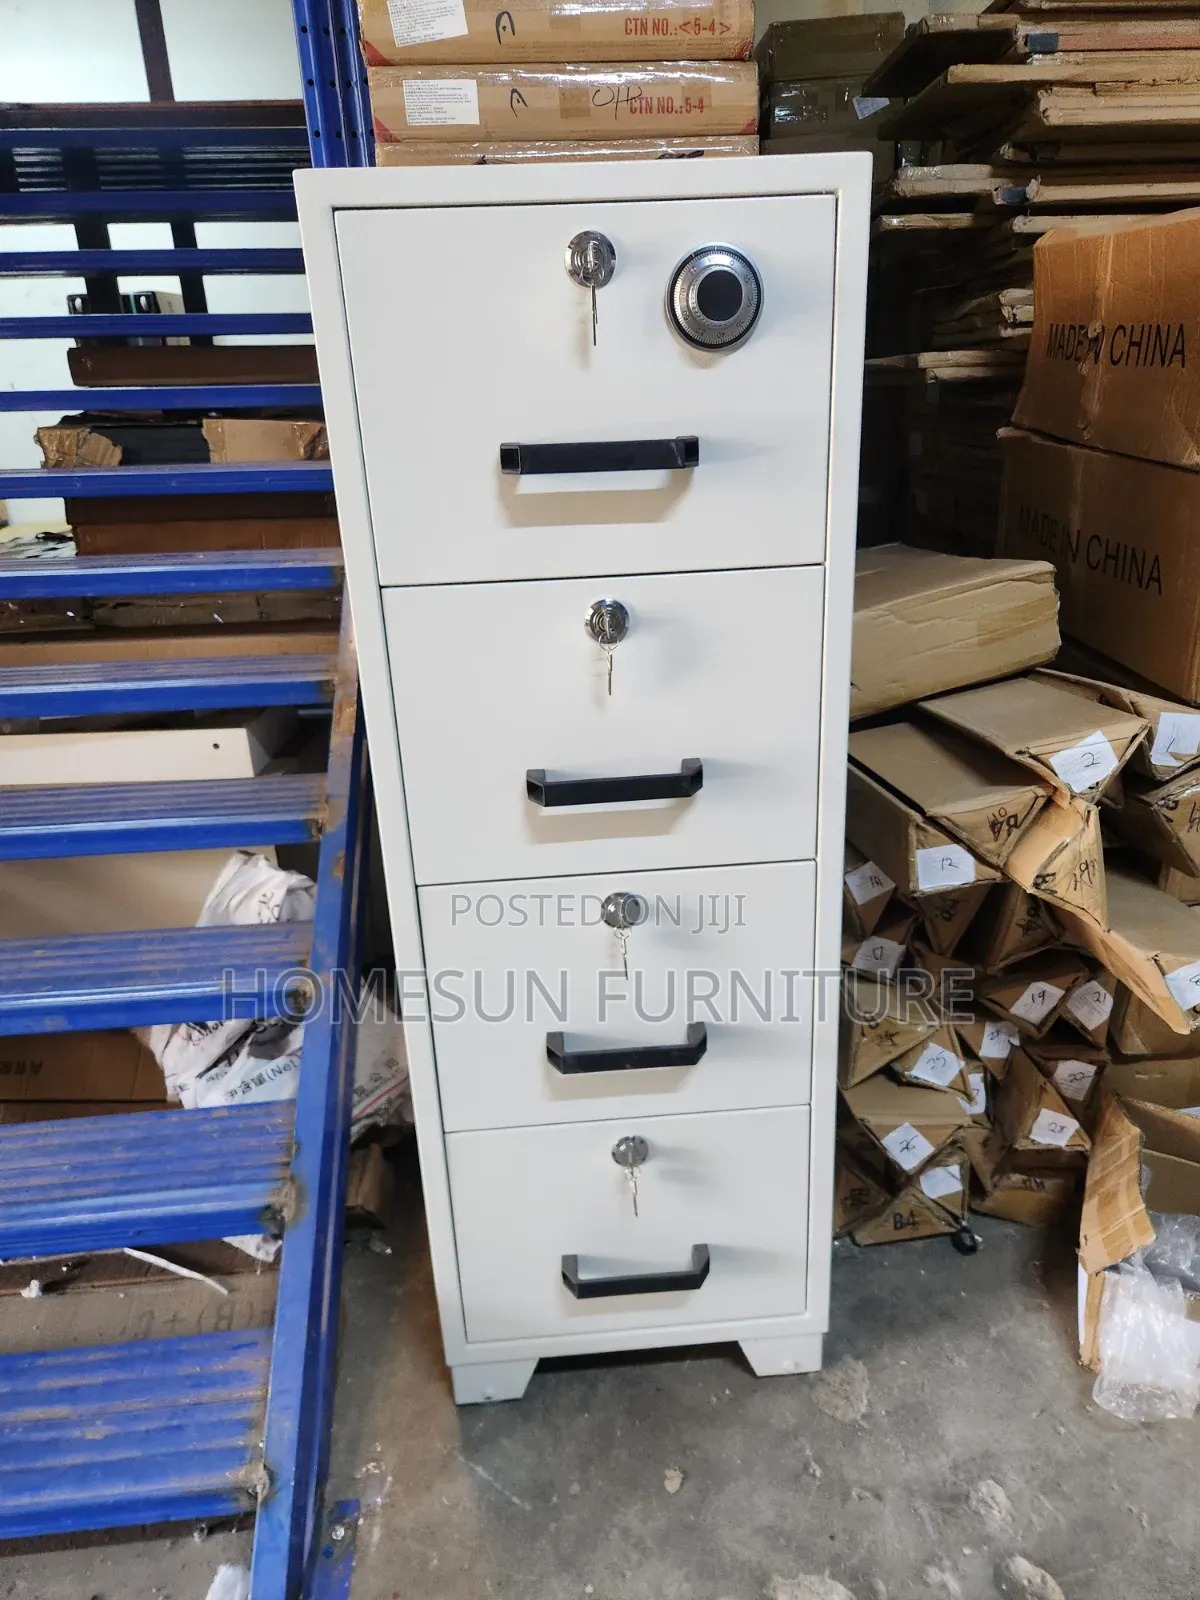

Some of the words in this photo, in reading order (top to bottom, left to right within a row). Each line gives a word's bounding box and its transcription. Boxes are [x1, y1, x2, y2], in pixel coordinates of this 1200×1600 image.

[624, 18, 648, 36] CTN
[629, 97, 653, 114] CTN
[1046, 323, 1085, 362] MADE
[1109, 323, 1186, 368] CHINA
[1019, 505, 1057, 553] MADE
[1061, 522, 1081, 564] IN
[1086, 534, 1163, 596] CHINA
[1081, 752, 1101, 768] 2
[941, 857, 959, 871] 12
[1031, 989, 1047, 1006] 19
